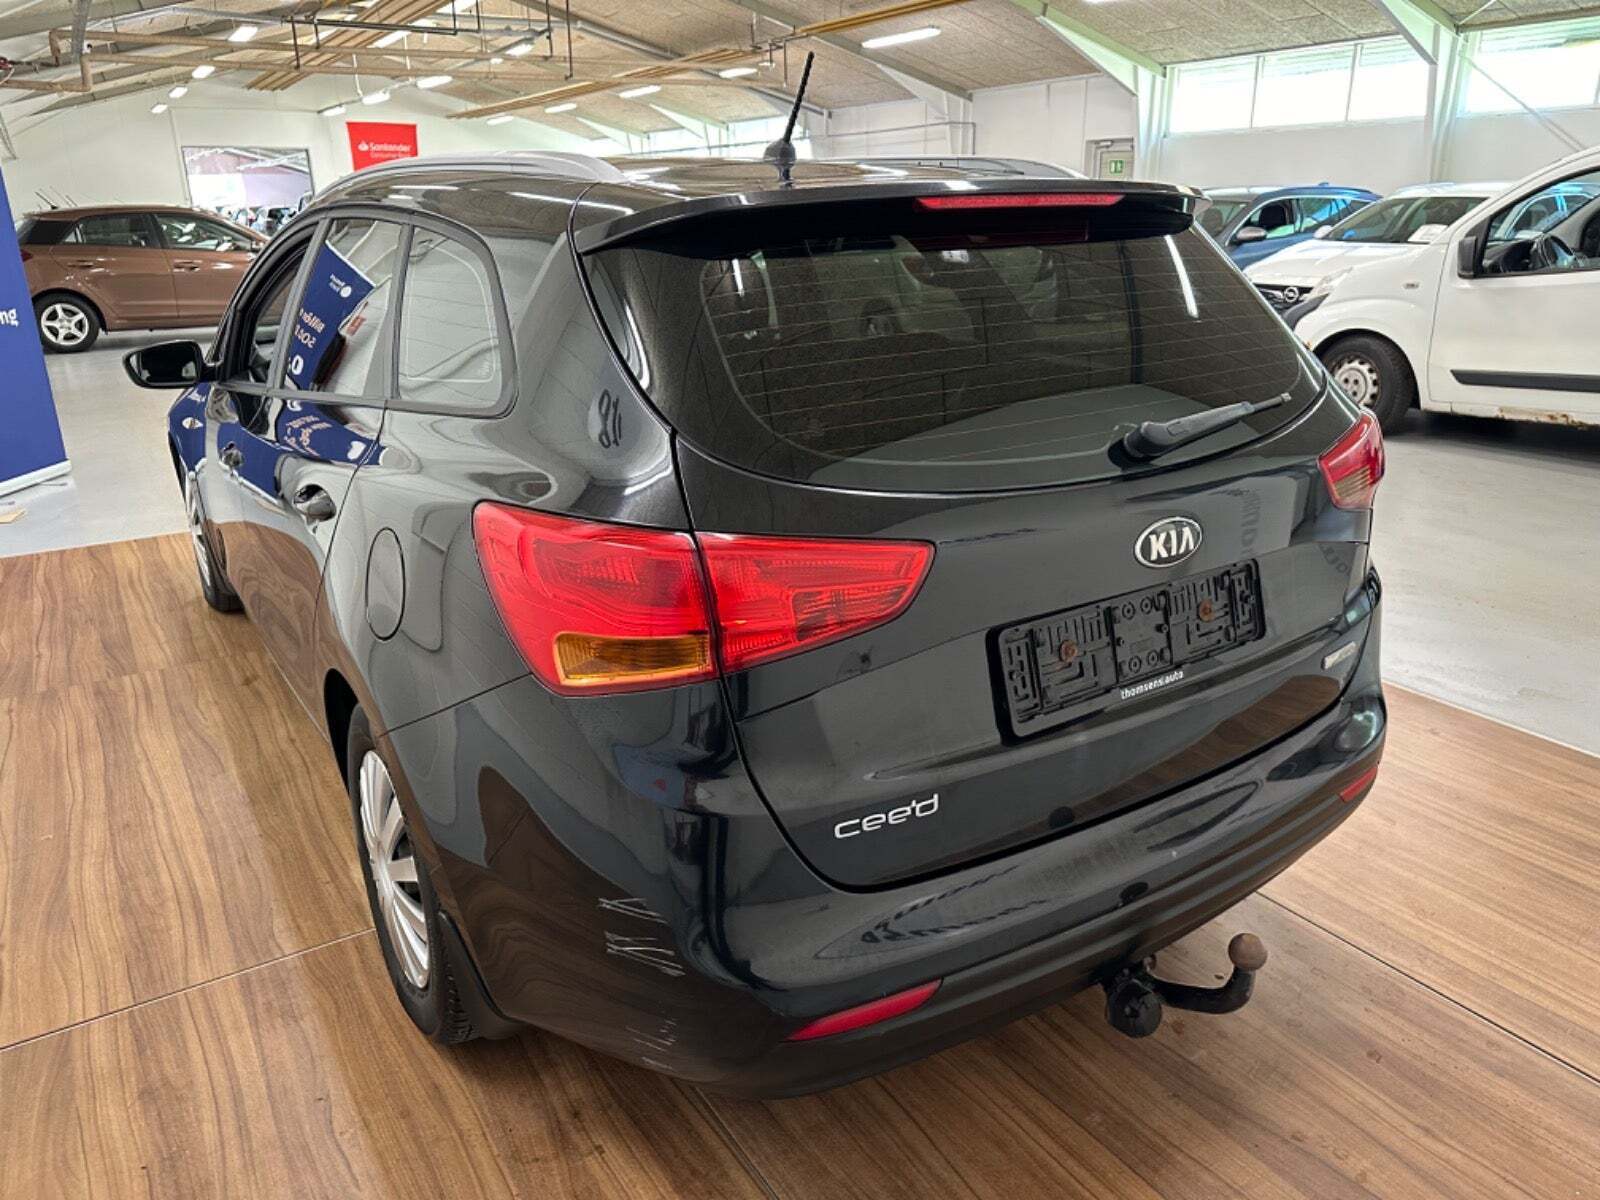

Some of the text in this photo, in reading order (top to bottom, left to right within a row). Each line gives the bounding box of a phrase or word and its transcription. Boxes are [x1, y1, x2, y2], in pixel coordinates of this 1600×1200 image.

[369, 142, 411, 152] Santander
[1147, 525, 1196, 561] KIA
[834, 793, 939, 839] cee'd
